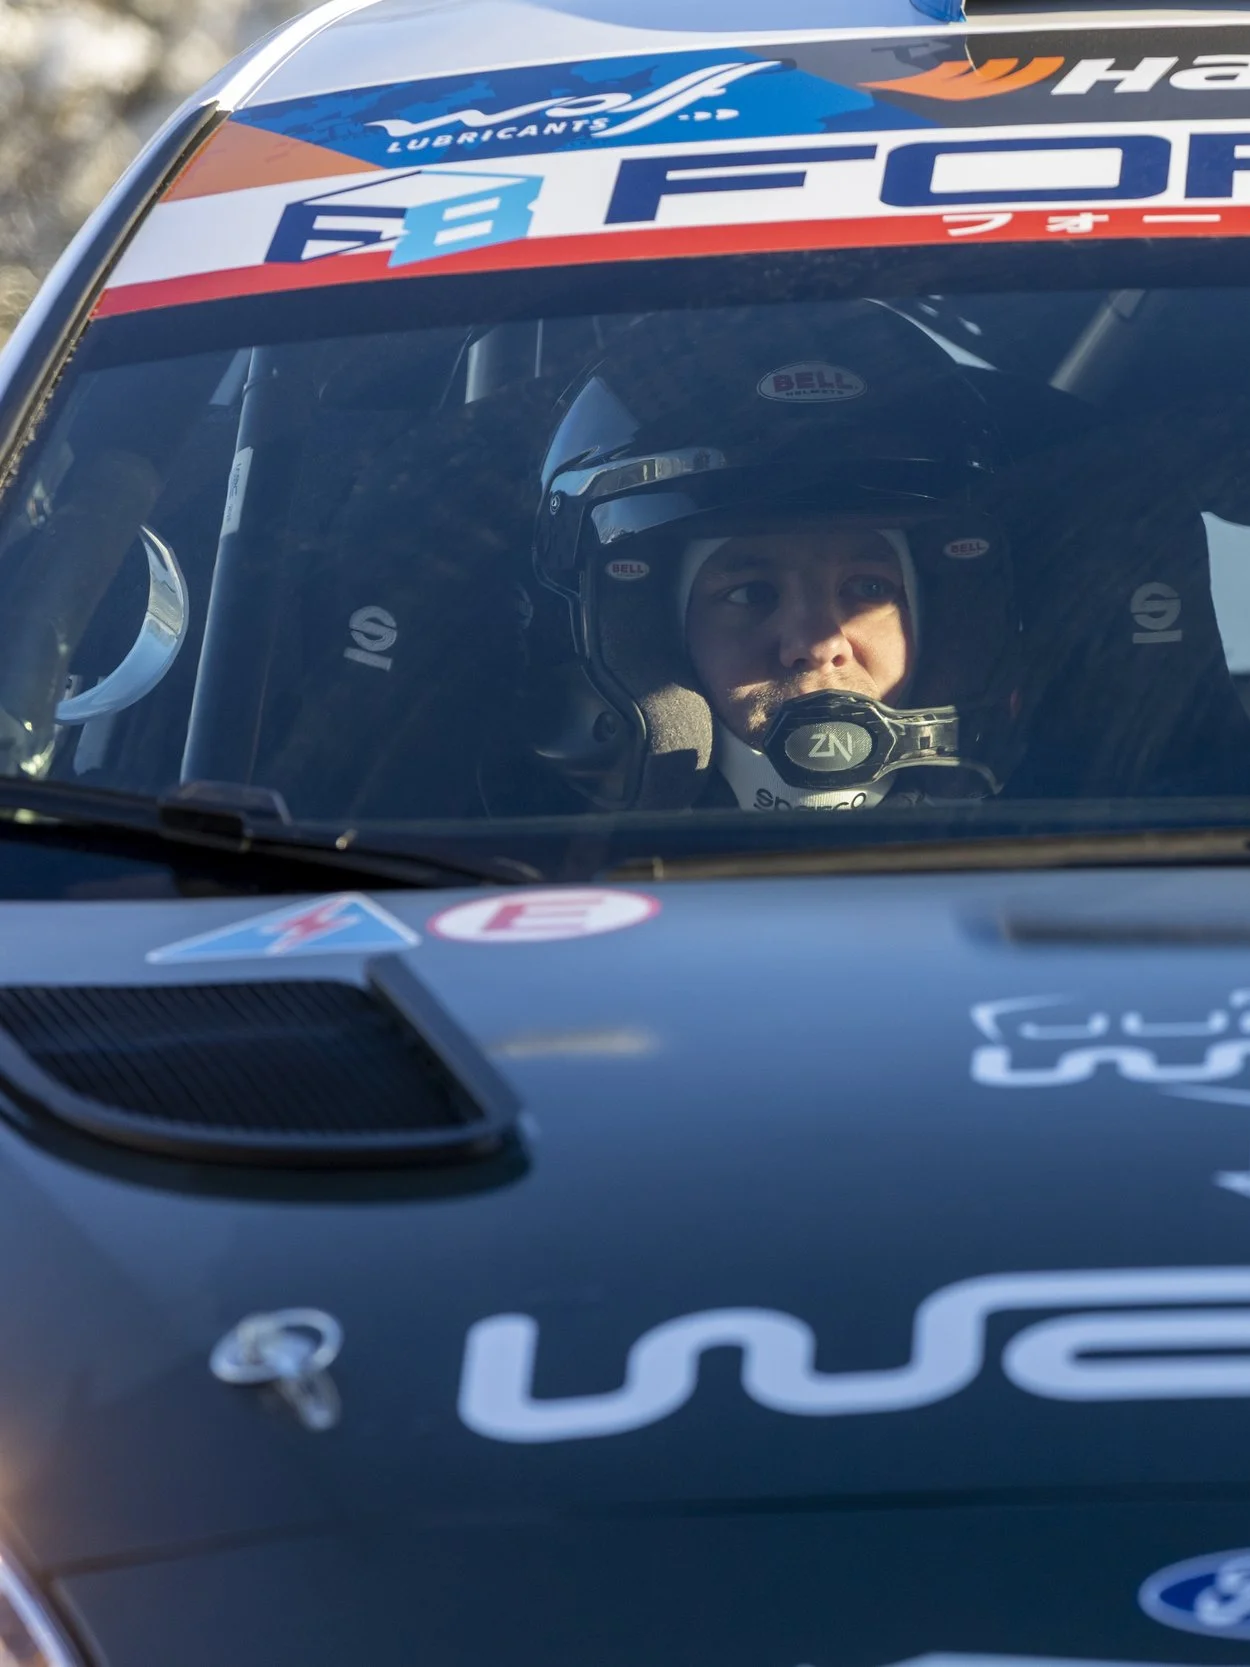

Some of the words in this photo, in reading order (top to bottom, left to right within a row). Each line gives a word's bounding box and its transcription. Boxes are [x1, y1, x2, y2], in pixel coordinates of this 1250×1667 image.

[386, 117, 610, 154] LUBRICANTS
[773, 371, 854, 393] BELL
[950, 541, 987, 554] BELL
[612, 563, 644, 574] BELL
[482, 898, 606, 932] E
